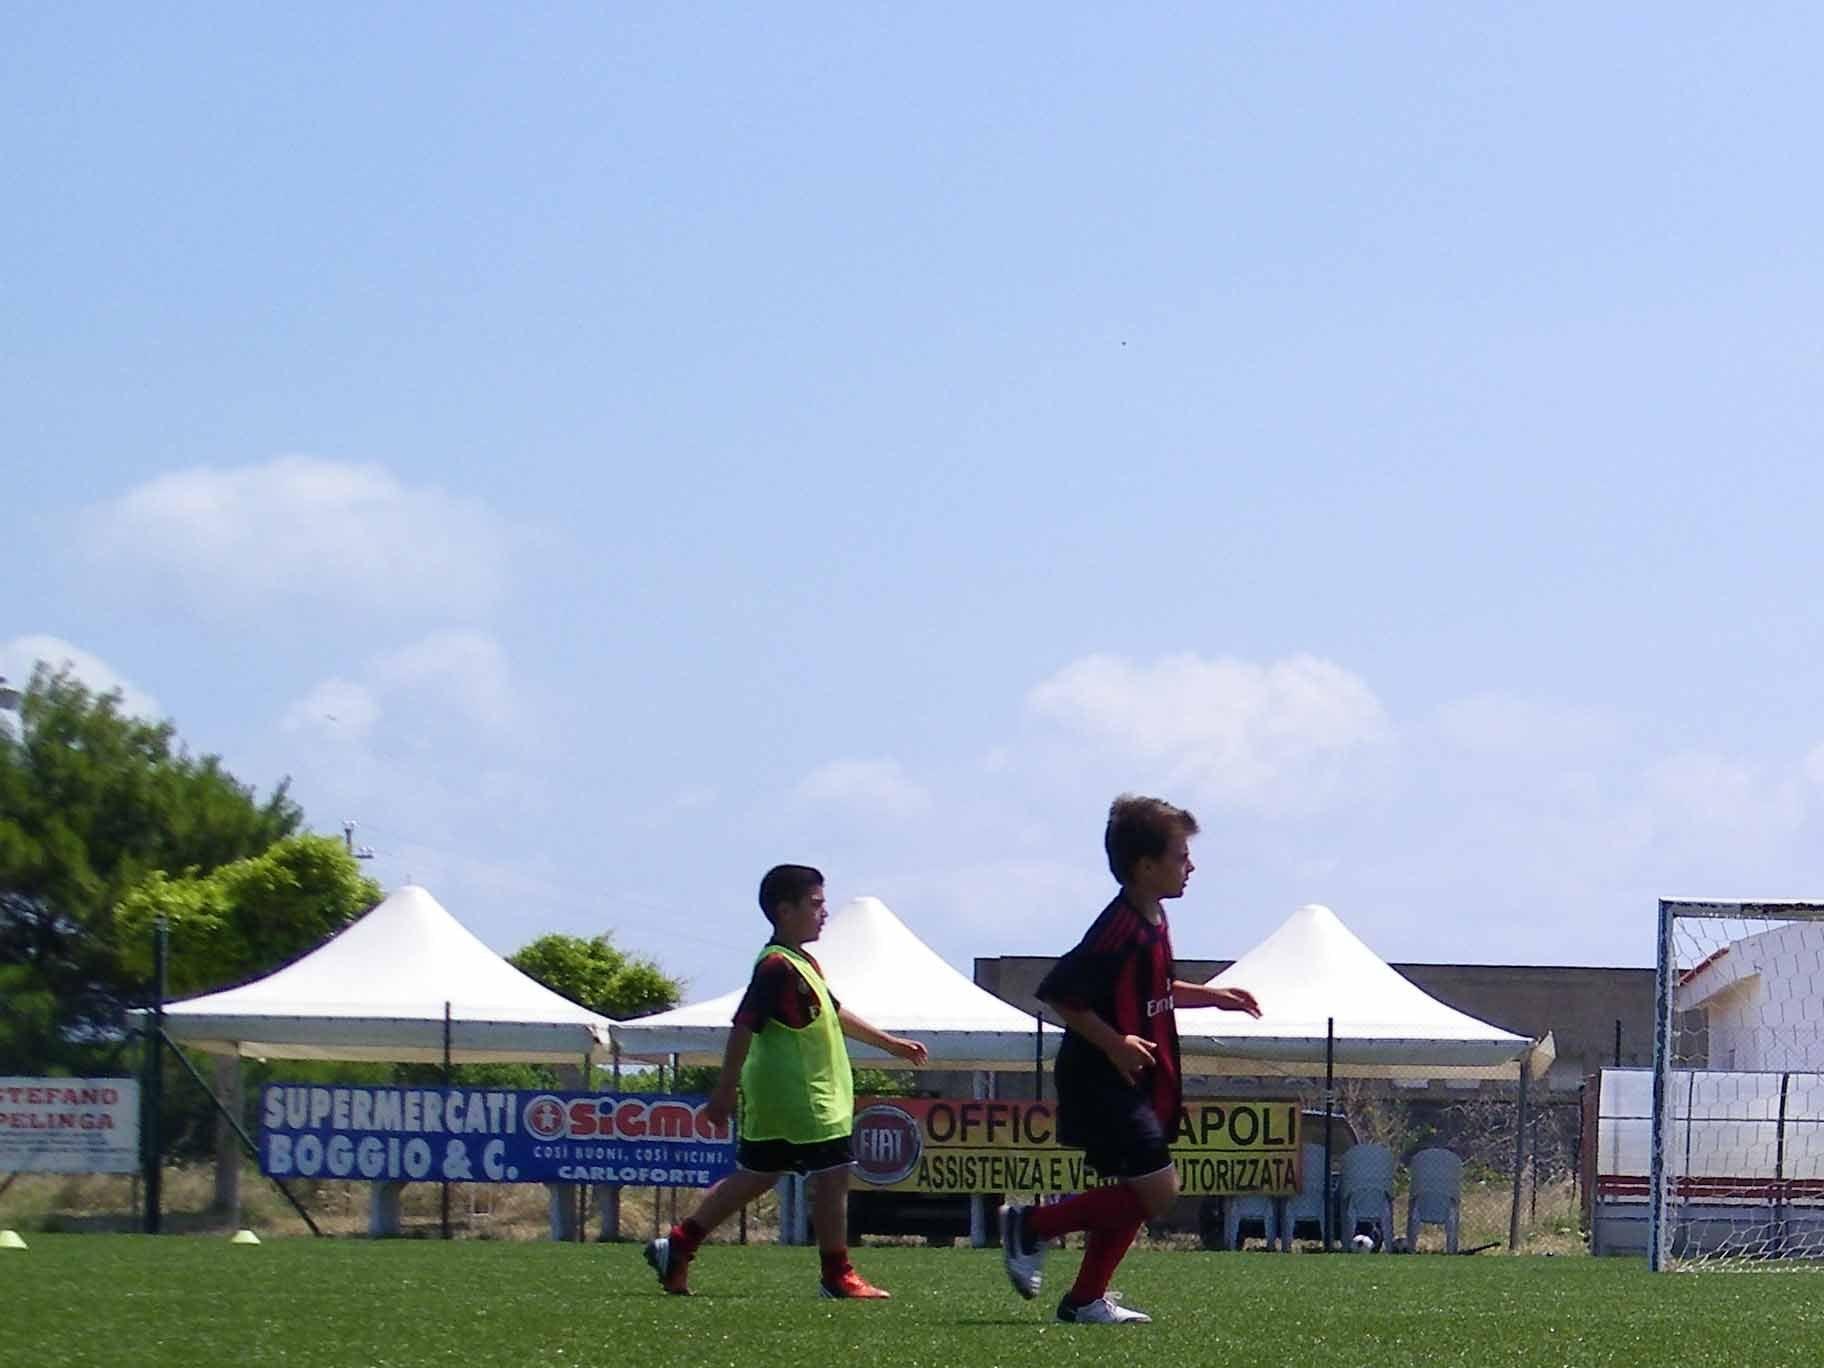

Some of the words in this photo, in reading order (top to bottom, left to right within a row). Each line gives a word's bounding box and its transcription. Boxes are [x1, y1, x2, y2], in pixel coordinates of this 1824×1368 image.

[0, 1088, 118, 1105] TEFANO
[263, 1086, 517, 1133] SUPERMERCATI
[926, 1103, 1054, 1144] OFFIC
[1173, 1105, 1296, 1146] APOLI
[268, 1133, 432, 1178] BOGGIO
[442, 1138, 473, 1179] &
[482, 1139, 519, 1180] C.
[859, 1127, 904, 1161] FIAT
[557, 1165, 710, 1184] CARLOFORTE
[918, 1155, 1044, 1190] ASSISTENZA
[1051, 1158, 1062, 1189] E
[1177, 1158, 1297, 1193] UTORIZZATA
